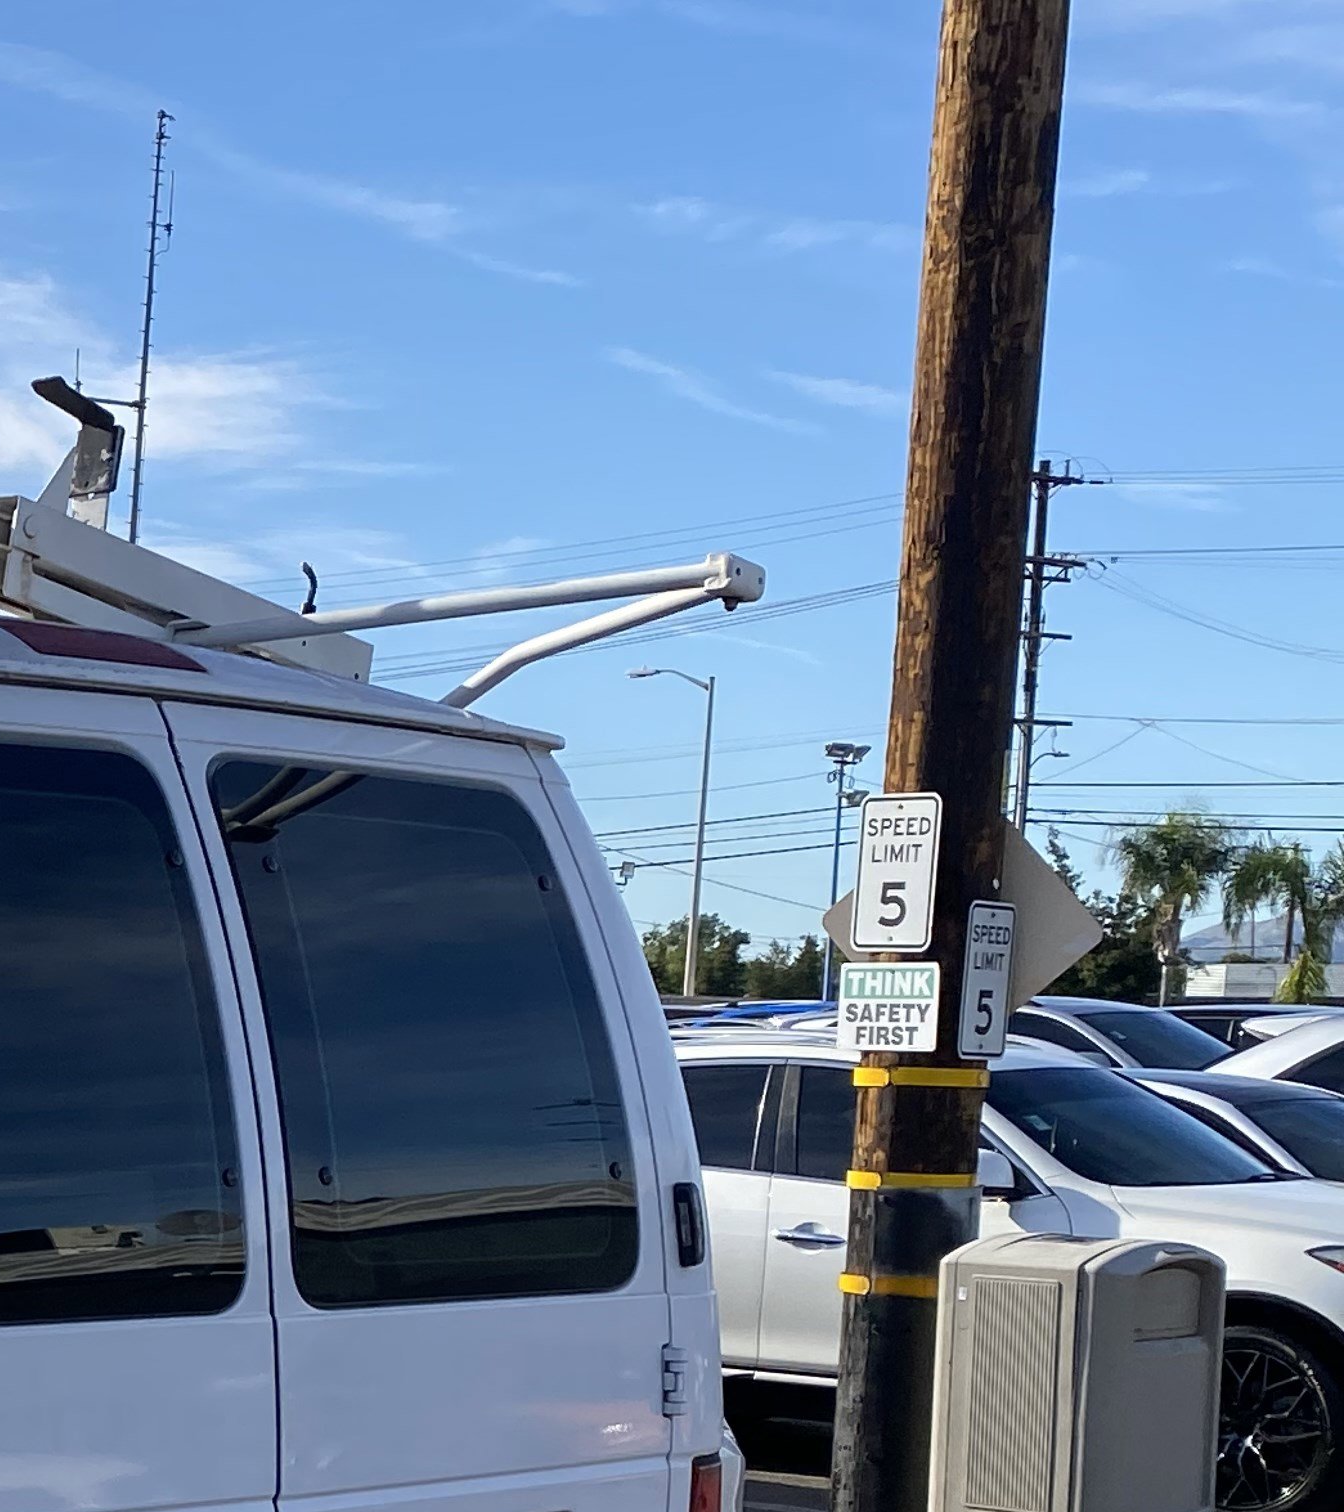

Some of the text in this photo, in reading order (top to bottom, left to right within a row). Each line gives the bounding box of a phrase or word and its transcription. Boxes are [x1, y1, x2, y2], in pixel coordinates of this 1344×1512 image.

[867, 816, 931, 837] SPEED
[870, 843, 923, 863] LIMIT
[877, 881, 907, 928] 5
[972, 923, 1011, 946] SPEED
[973, 952, 1006, 972] LIMIT
[848, 970, 932, 997] THINK
[845, 1003, 931, 1024] SAFETY
[974, 989, 994, 1036] 5
[855, 1026, 919, 1046] FIRST
